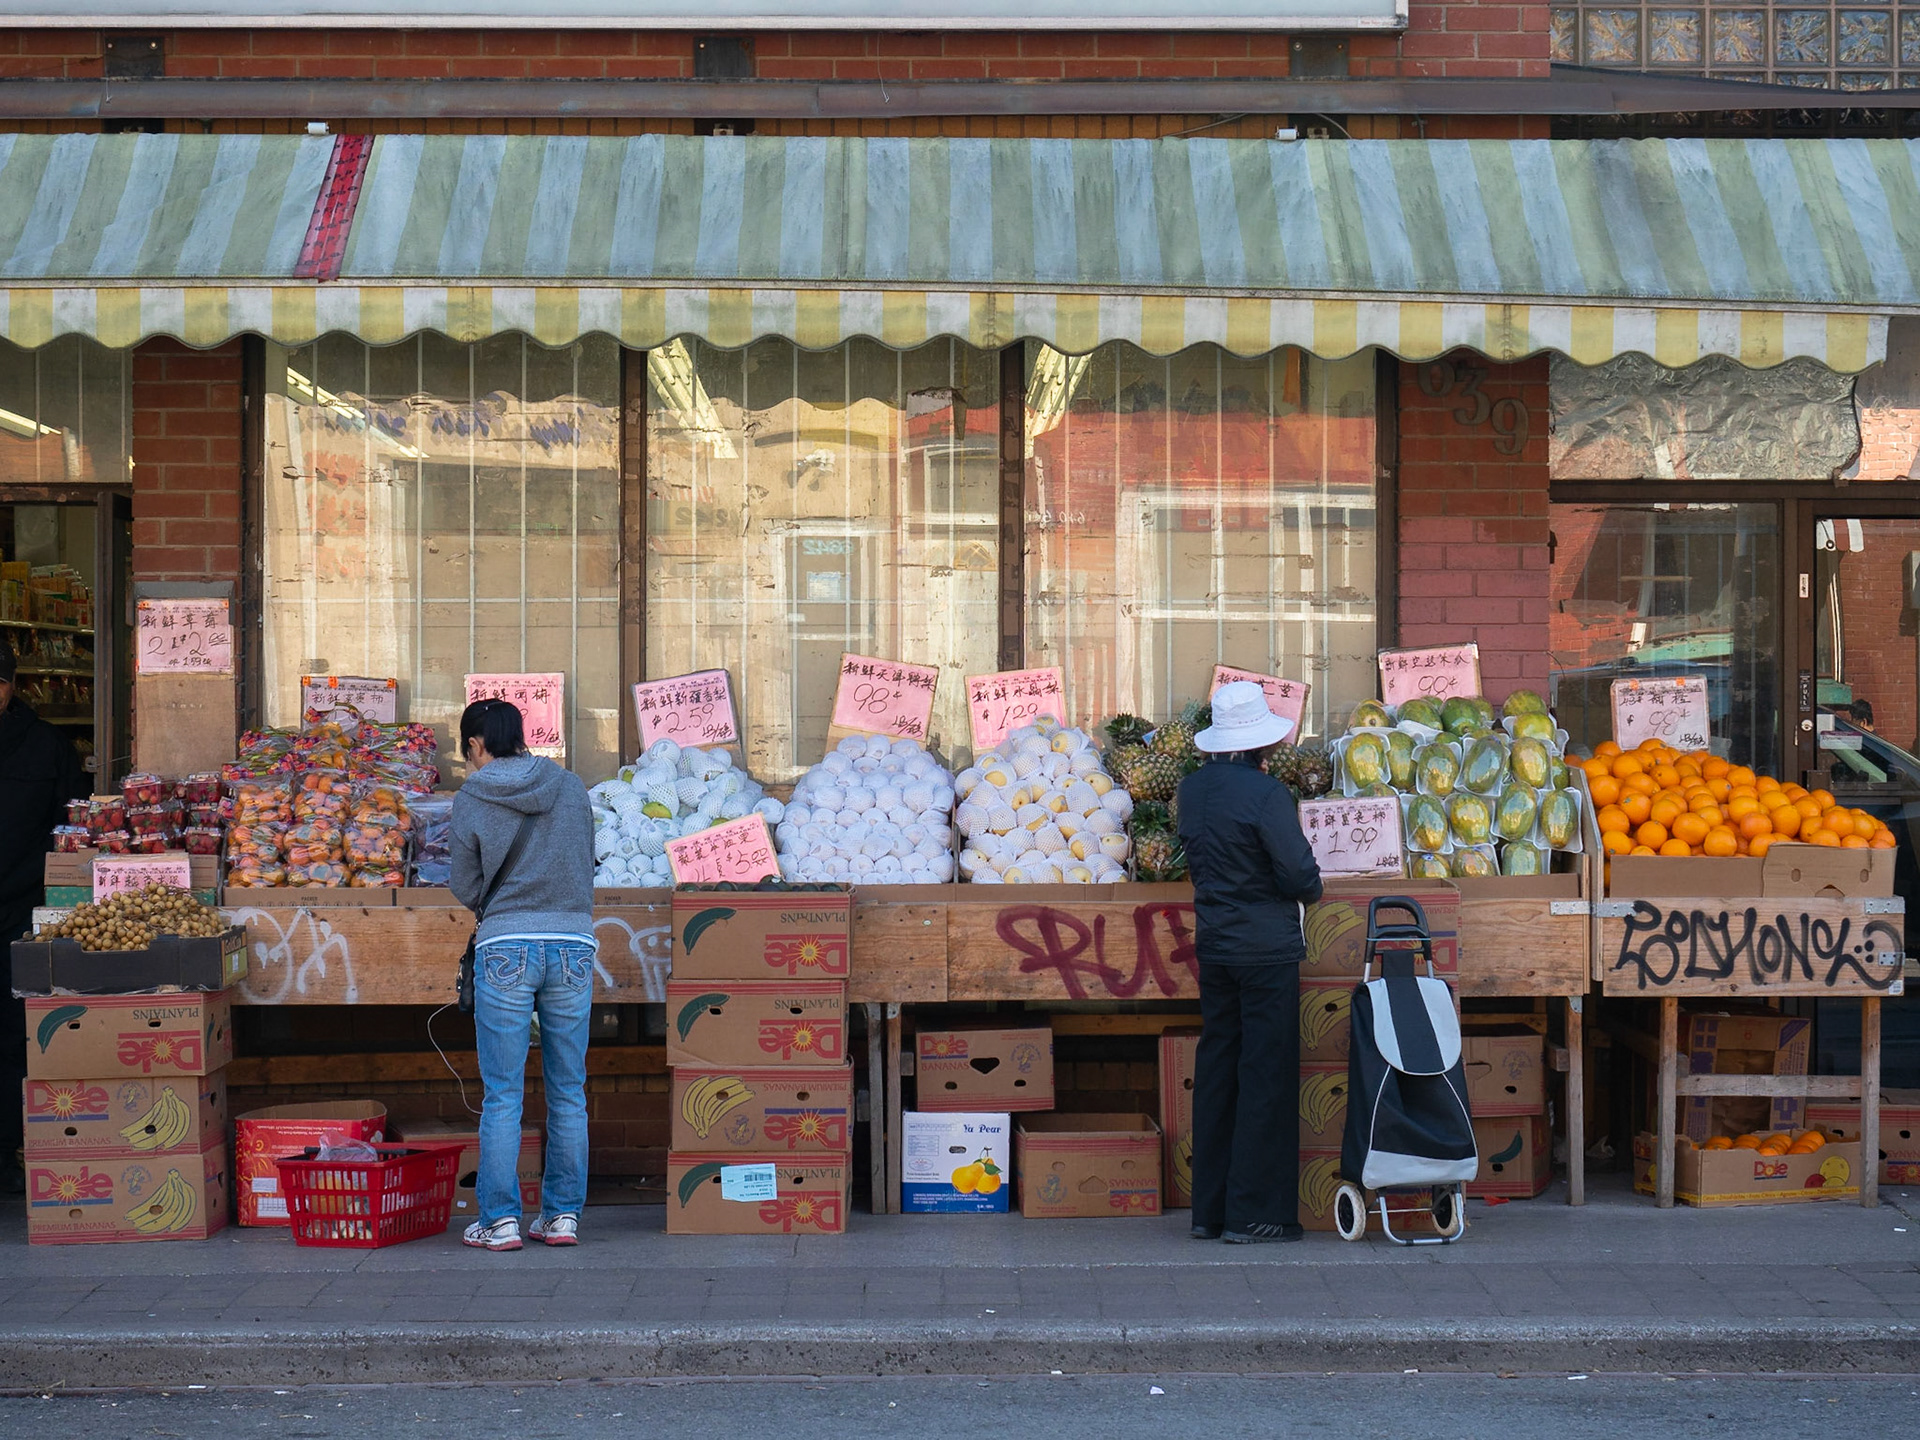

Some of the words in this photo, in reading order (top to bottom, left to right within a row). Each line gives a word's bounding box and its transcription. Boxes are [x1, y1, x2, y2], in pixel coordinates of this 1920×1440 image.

[764, 940, 848, 976] Dole
[117, 1037, 203, 1074] Dole
[758, 1025, 842, 1061] Dole
[921, 1034, 969, 1055] Dole
[921, 1061, 970, 1072] BANANAS
[26, 1079, 109, 1114] Dole
[28, 1138, 67, 1148] PREMIUM
[68, 1136, 112, 1147] BANANAS
[763, 1115, 847, 1150] Dole
[978, 1123, 1002, 1134] Pear
[29, 1165, 114, 1200] Dole
[1753, 1160, 1789, 1178] Dole
[758, 1199, 842, 1233] Dole
[1109, 1193, 1158, 1213] Dole
[32, 1222, 72, 1233] PREMIUM
[73, 1221, 117, 1232] BANANAS
